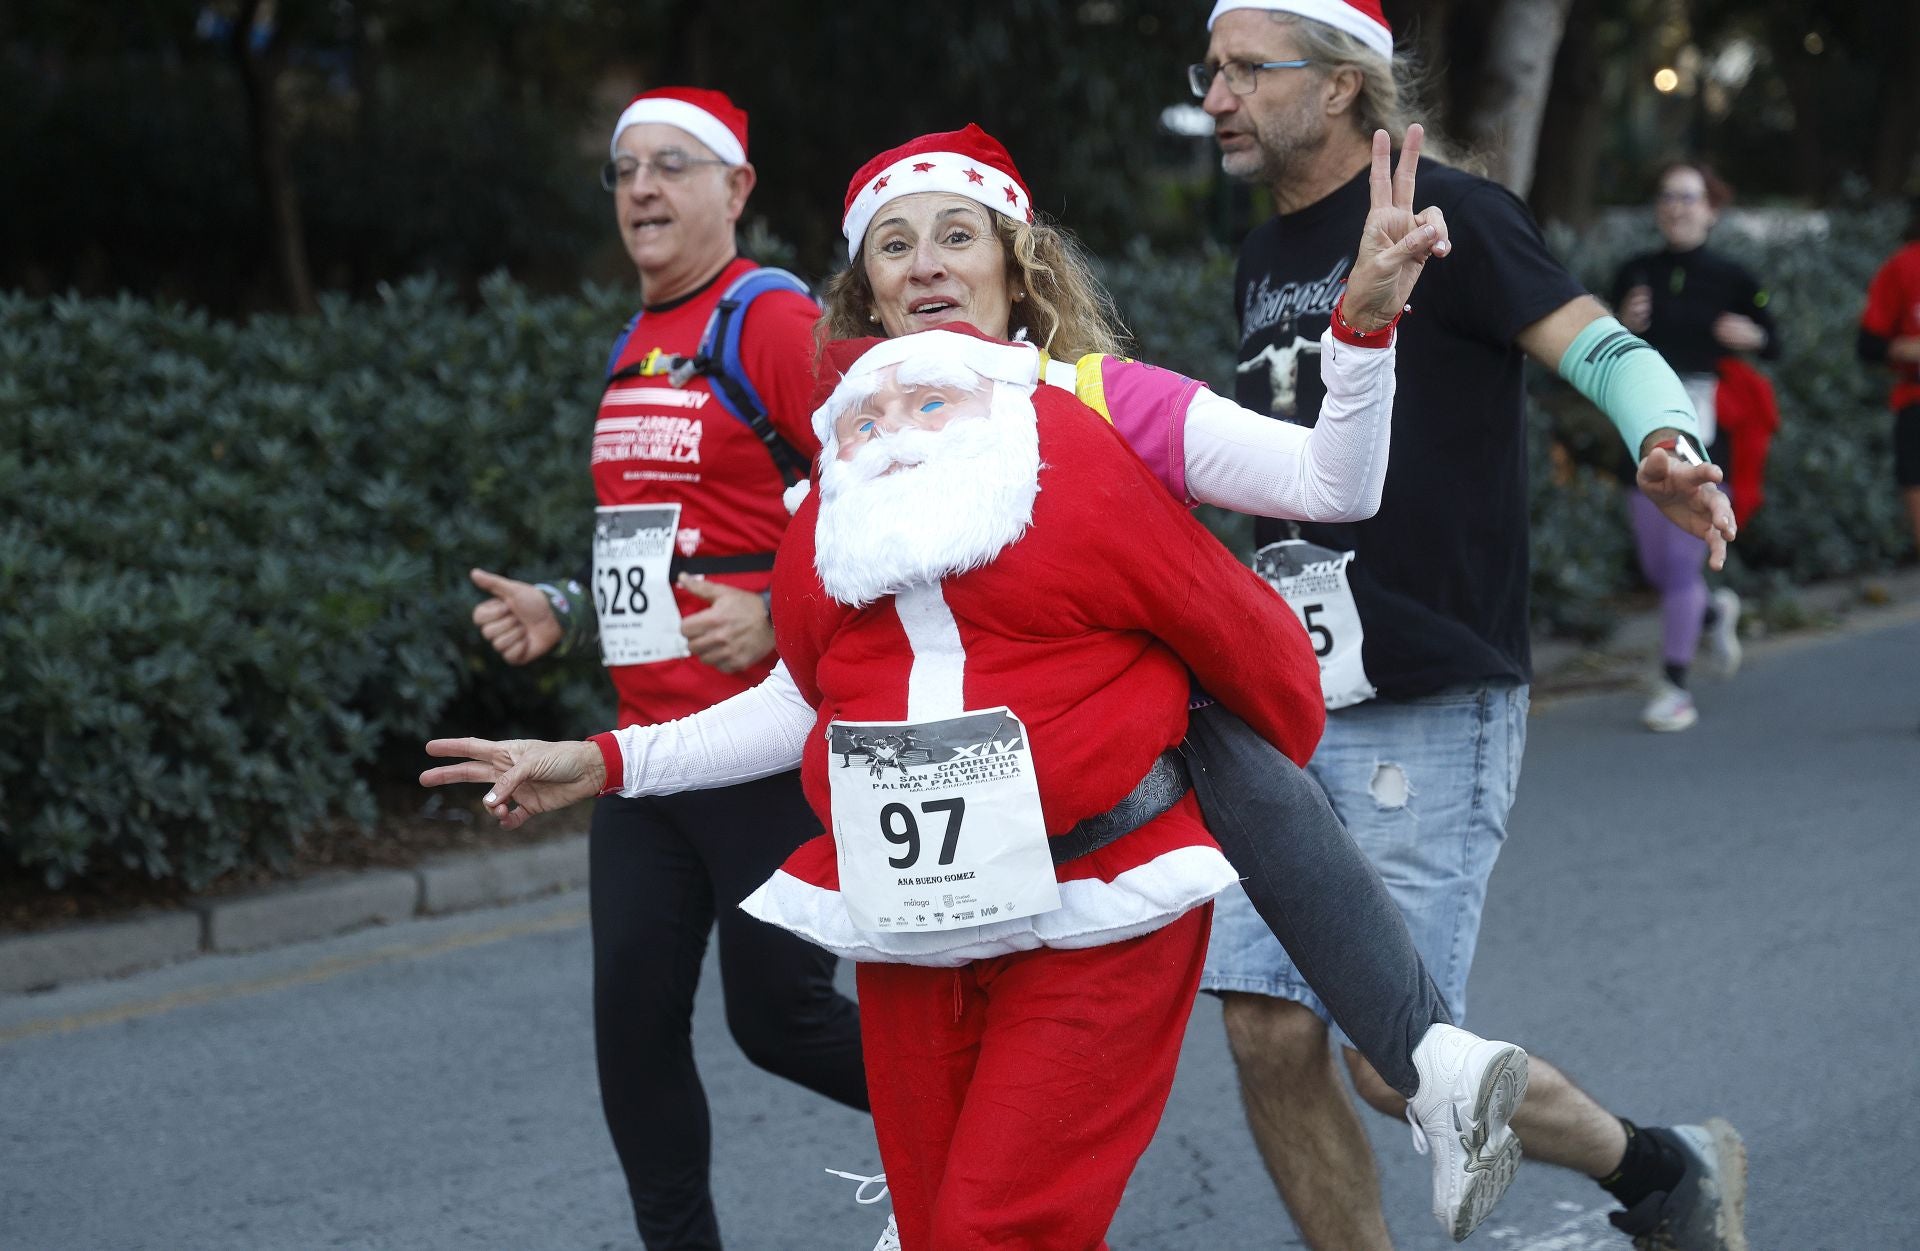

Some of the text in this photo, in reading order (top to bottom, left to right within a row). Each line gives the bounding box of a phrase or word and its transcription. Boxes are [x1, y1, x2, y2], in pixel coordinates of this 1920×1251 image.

[1302, 560, 1342, 575] XIV
[1303, 603, 1334, 657] 5
[949, 737, 1021, 761] XIV
[899, 760, 1020, 783] SAN SILVESTRE
[937, 753, 1018, 772] CARRERA
[872, 767, 1021, 790] PALMA PALMILLA
[879, 797, 965, 869] 97
[897, 871, 976, 886] ANA BUENO GOMEZ
